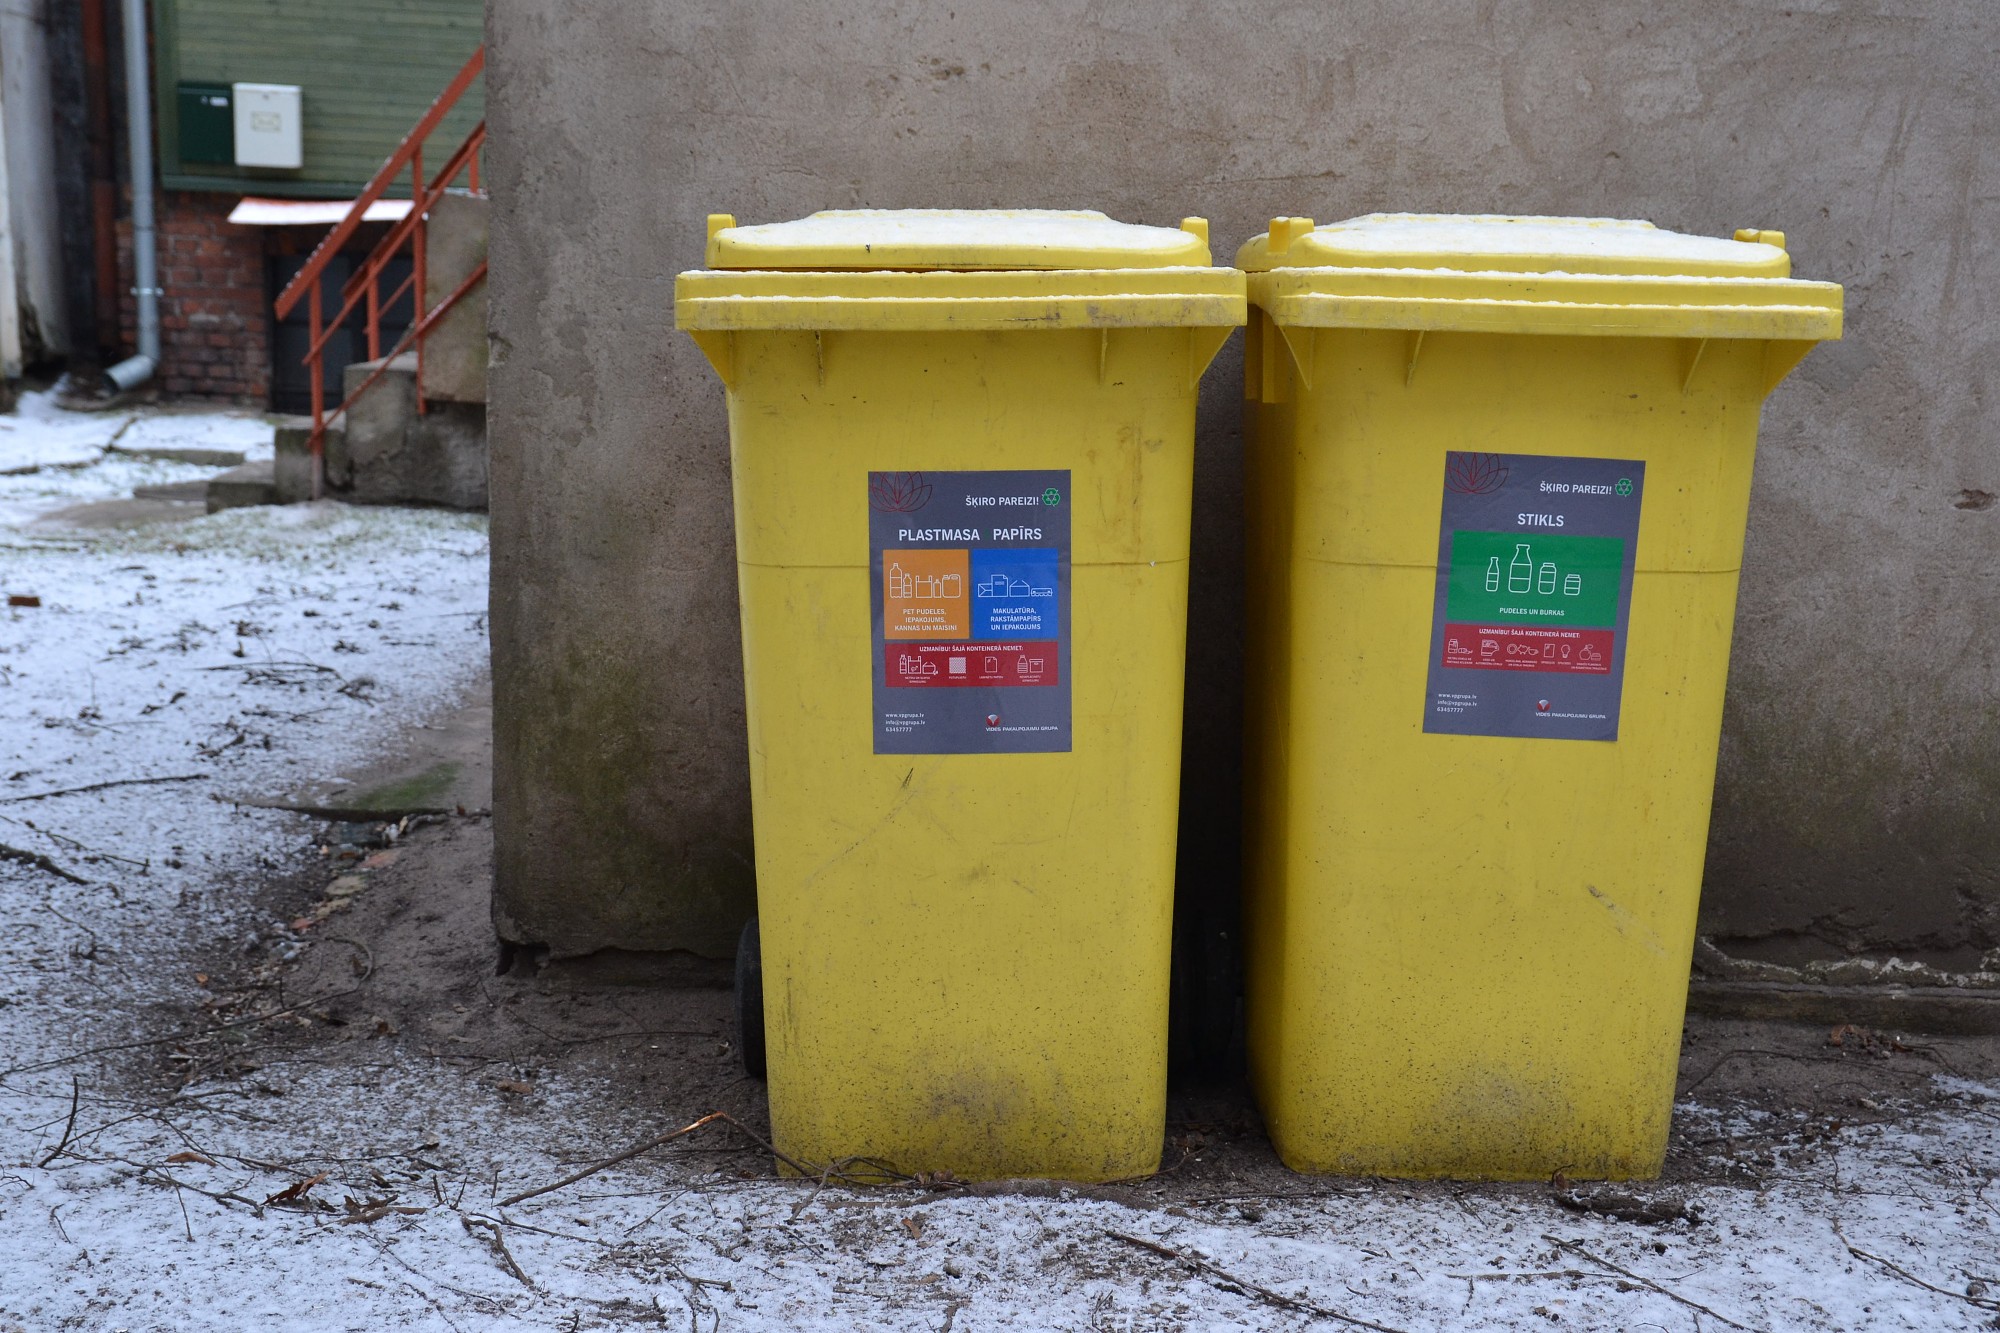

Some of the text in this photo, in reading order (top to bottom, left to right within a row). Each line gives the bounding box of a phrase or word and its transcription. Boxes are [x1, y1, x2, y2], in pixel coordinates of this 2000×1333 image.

[1540, 481, 1612, 495] ŠĶIRO PAREIZI!
[965, 495, 1039, 507] ŠĶIRO PAREIZI!
[1518, 513, 1564, 527] STIKLS
[899, 526, 1042, 541] PLASTMASA PAPĪRS
